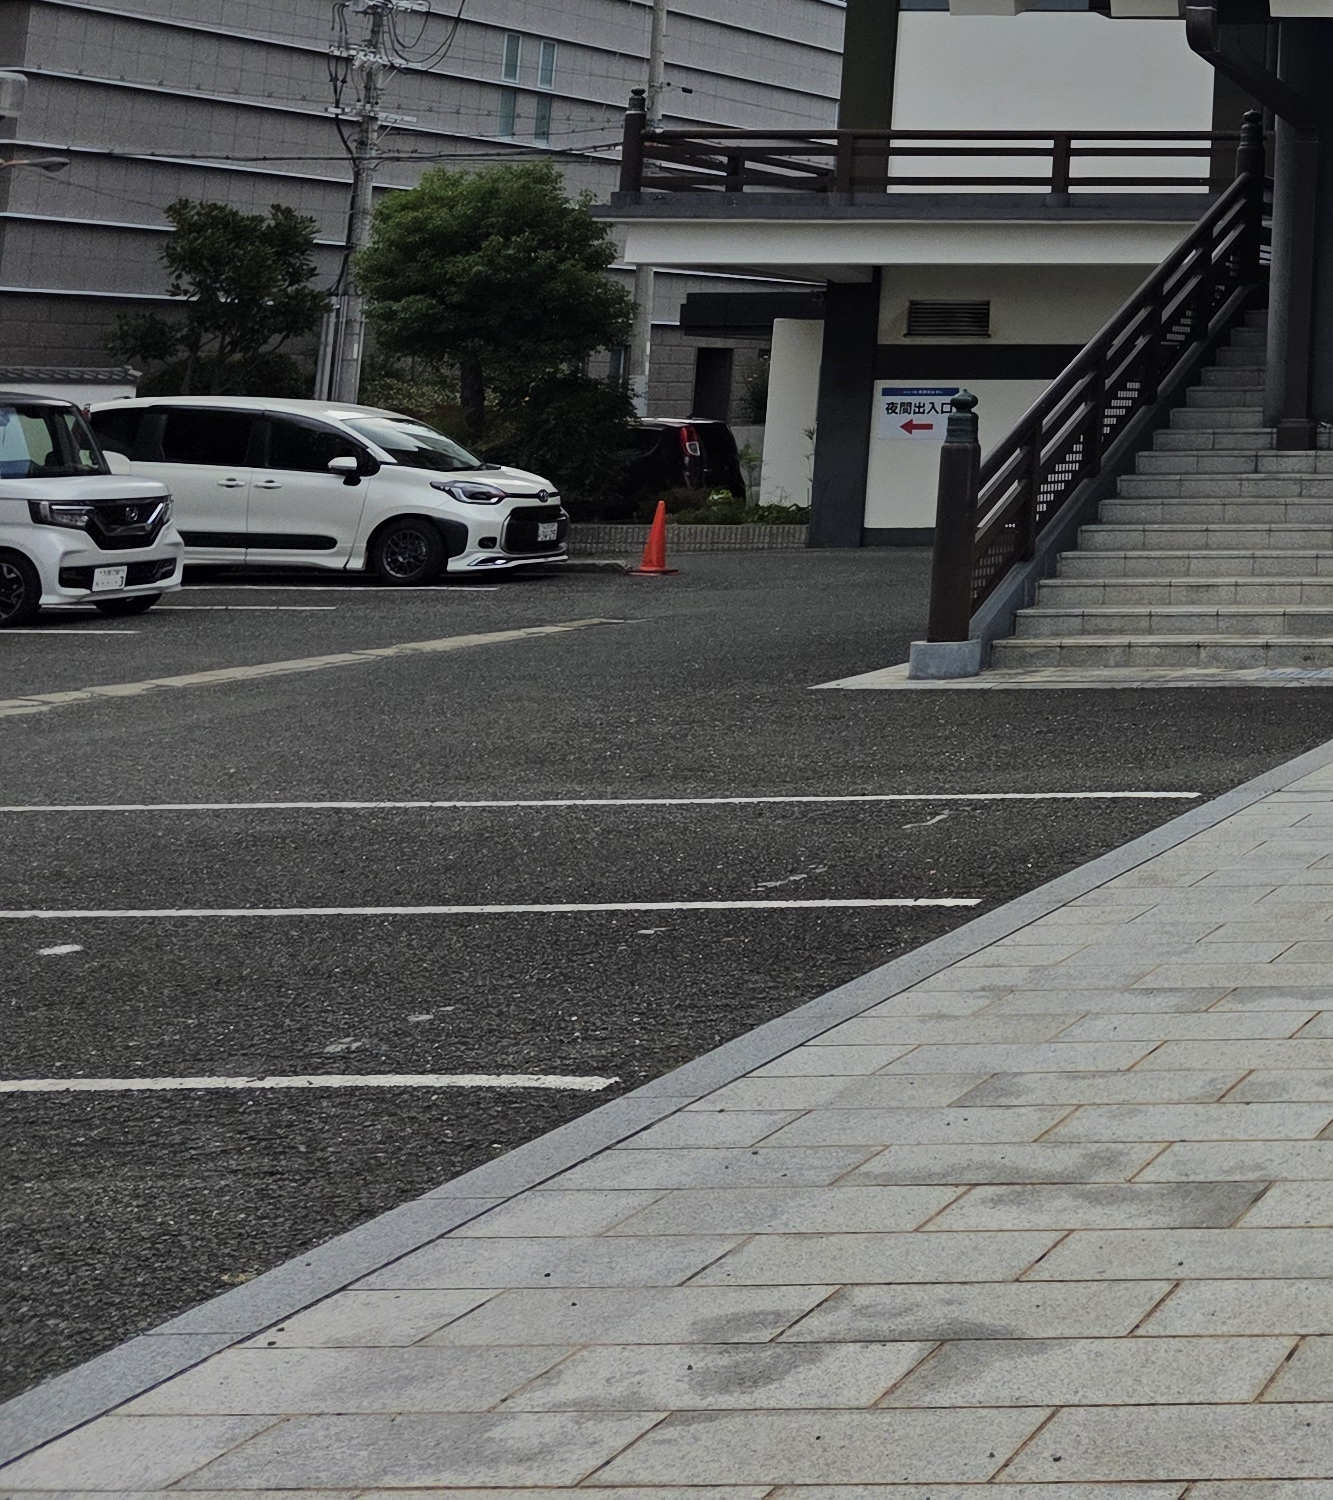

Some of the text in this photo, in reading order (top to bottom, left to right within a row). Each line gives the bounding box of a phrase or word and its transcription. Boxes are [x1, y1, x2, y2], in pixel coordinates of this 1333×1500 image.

[885, 402, 953, 415] 夜間出入口
